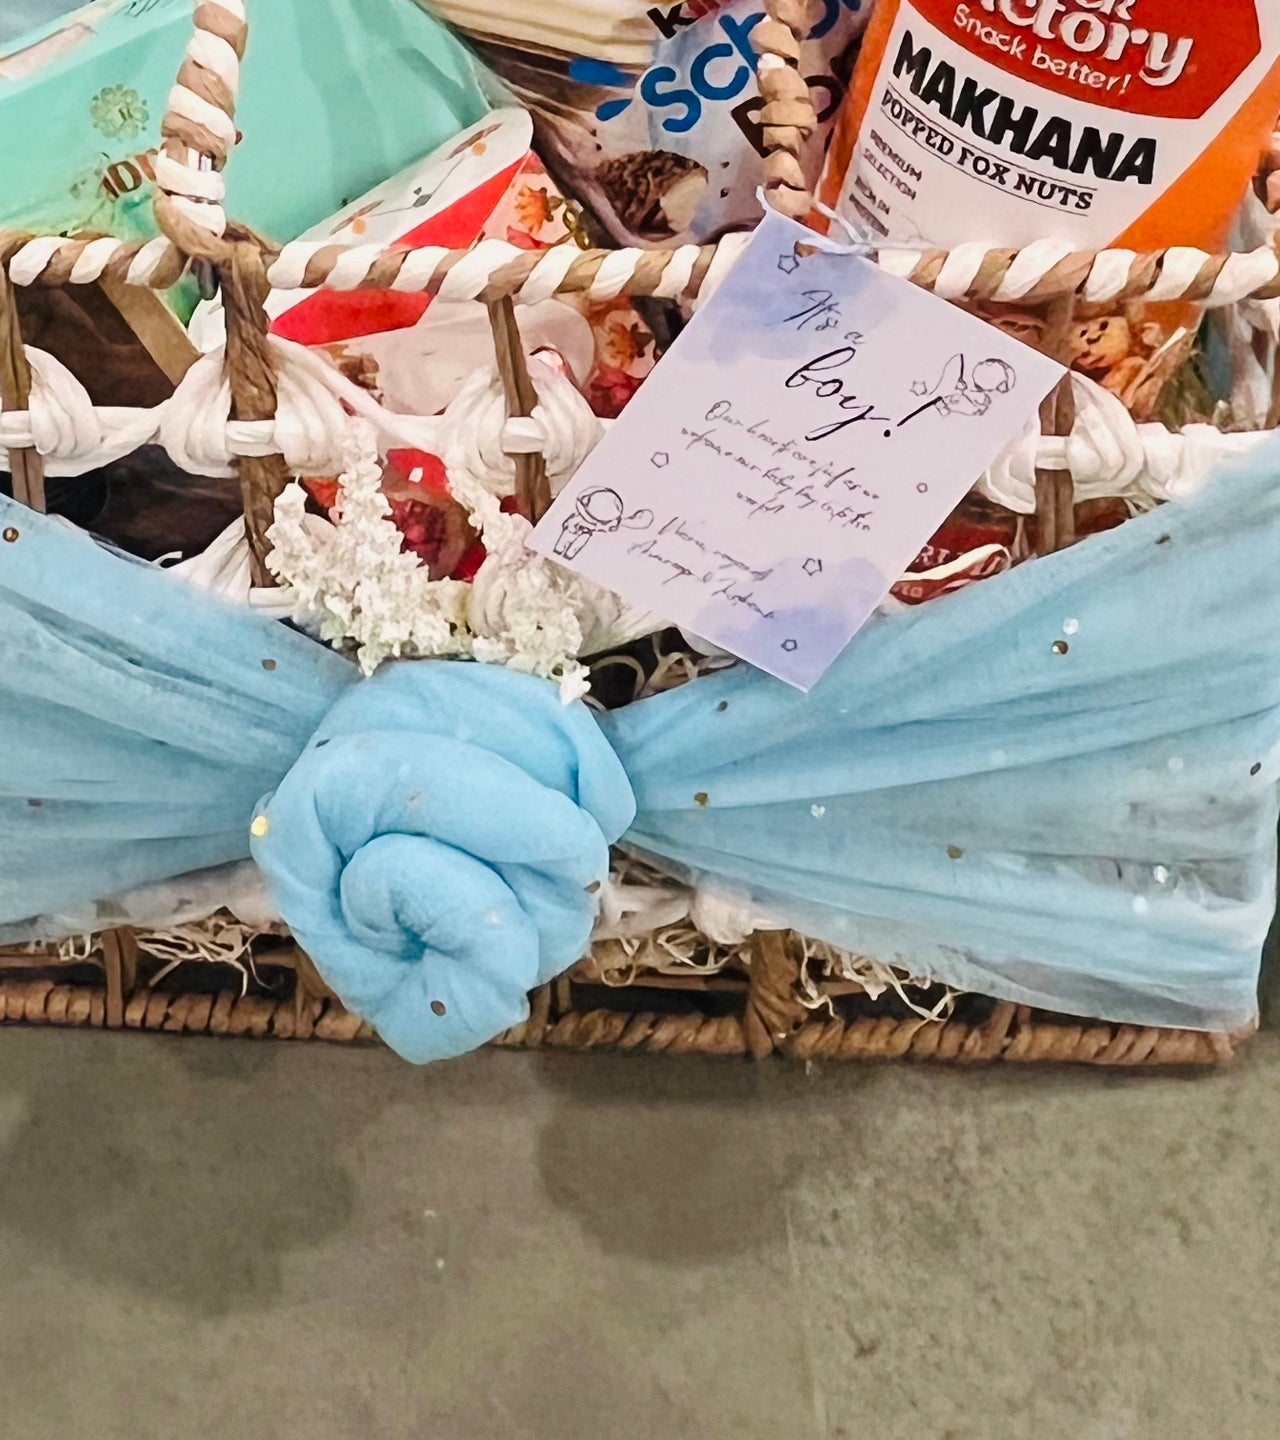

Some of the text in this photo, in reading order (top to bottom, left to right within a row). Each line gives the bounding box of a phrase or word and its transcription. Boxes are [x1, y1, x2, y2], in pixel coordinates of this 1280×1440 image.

[953, 2, 1133, 96] Snack better!
[881, 87, 955, 157] POPPED
[957, 146, 1013, 185] FOX
[1013, 173, 1094, 210] NUTS
[891, 29, 1159, 187] MAKHANA
[785, 346, 944, 441] boy!
